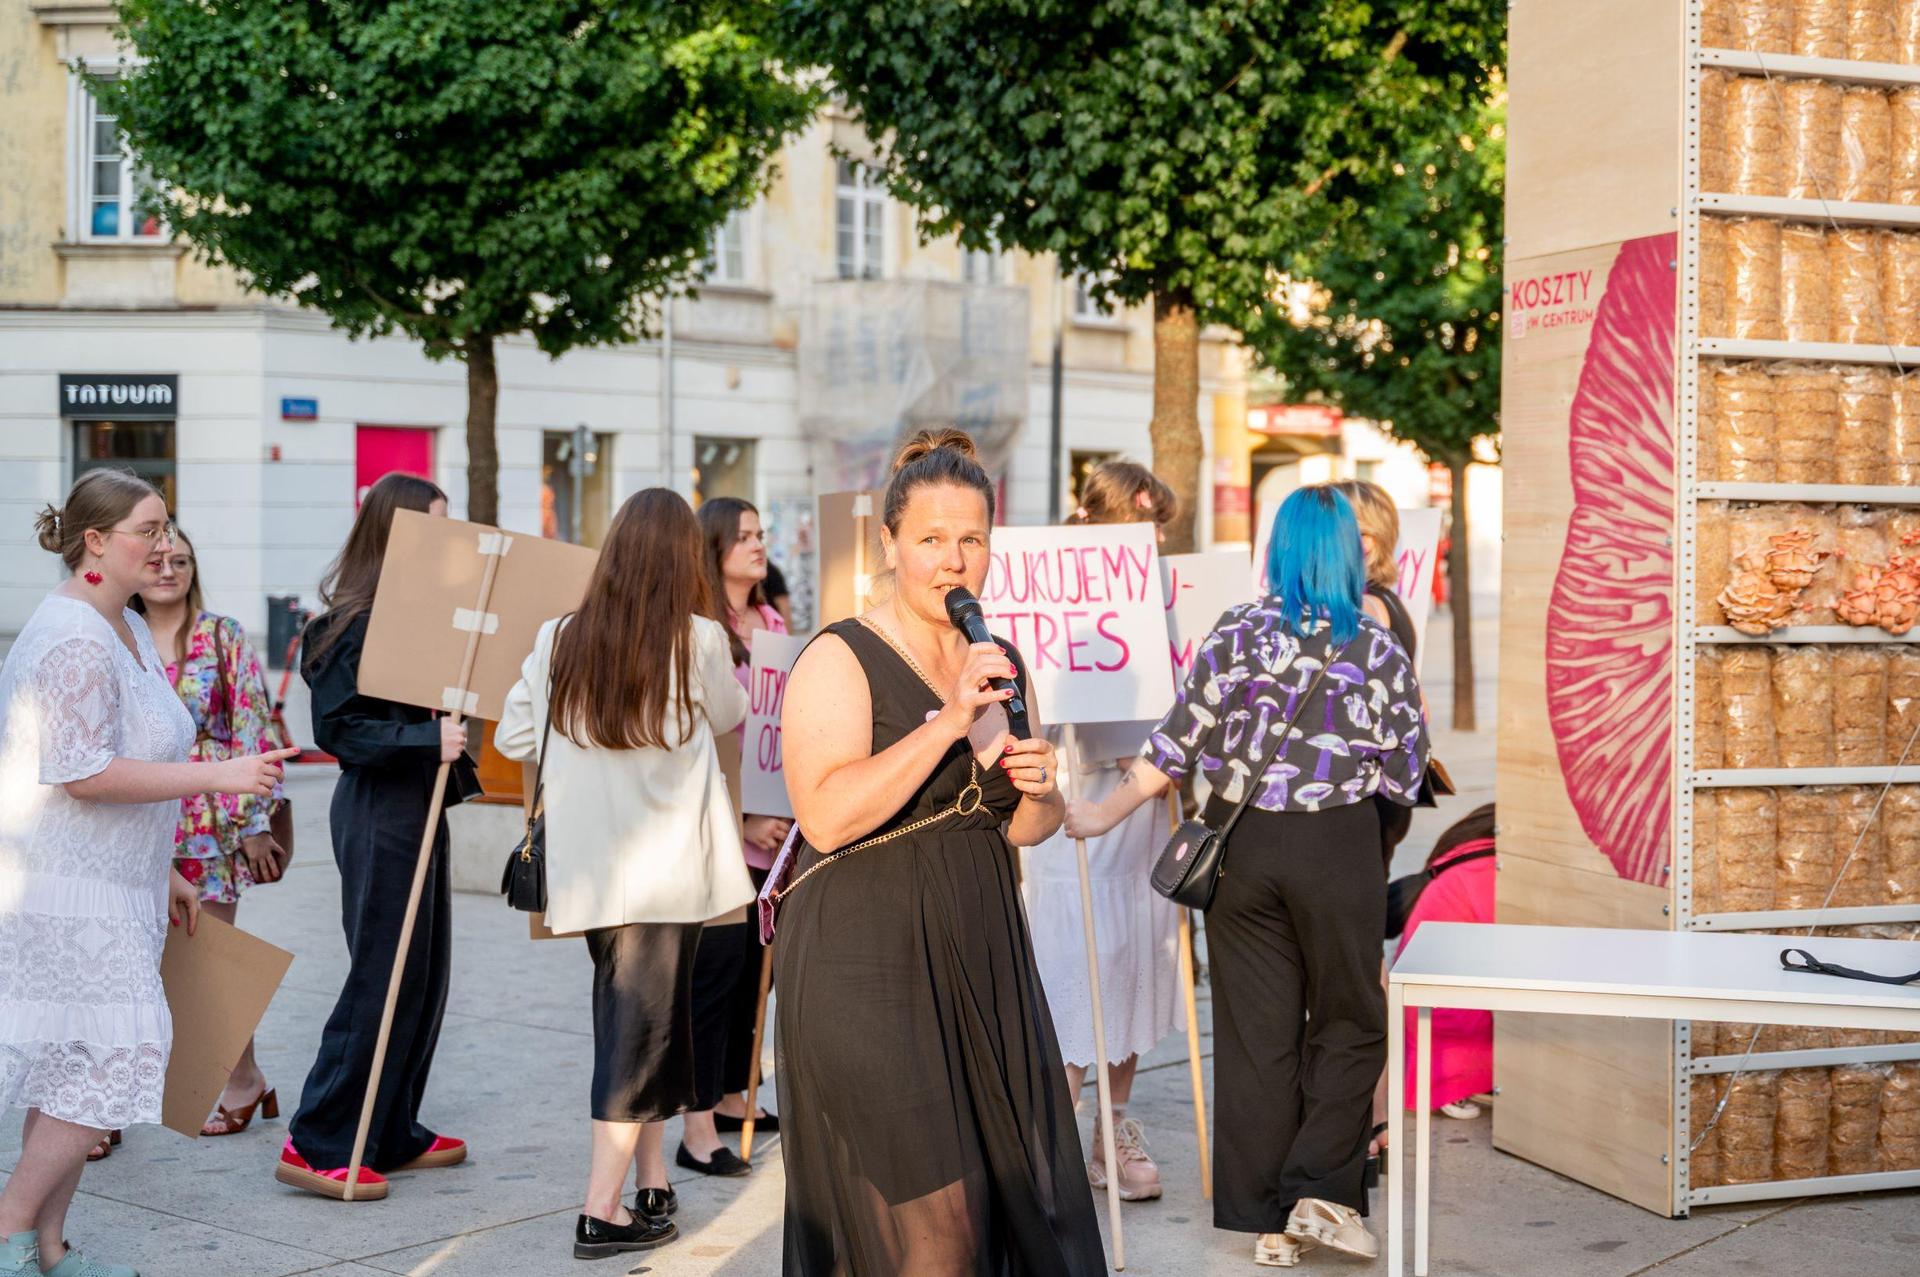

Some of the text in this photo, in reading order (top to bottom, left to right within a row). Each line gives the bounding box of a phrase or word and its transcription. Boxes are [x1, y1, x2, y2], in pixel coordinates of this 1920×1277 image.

[1512, 270, 1592, 310] KOSZTY
[1543, 310, 1593, 328] CENTRUM
[64, 384, 173, 404] TATUUM
[983, 610, 1131, 673] TRES
